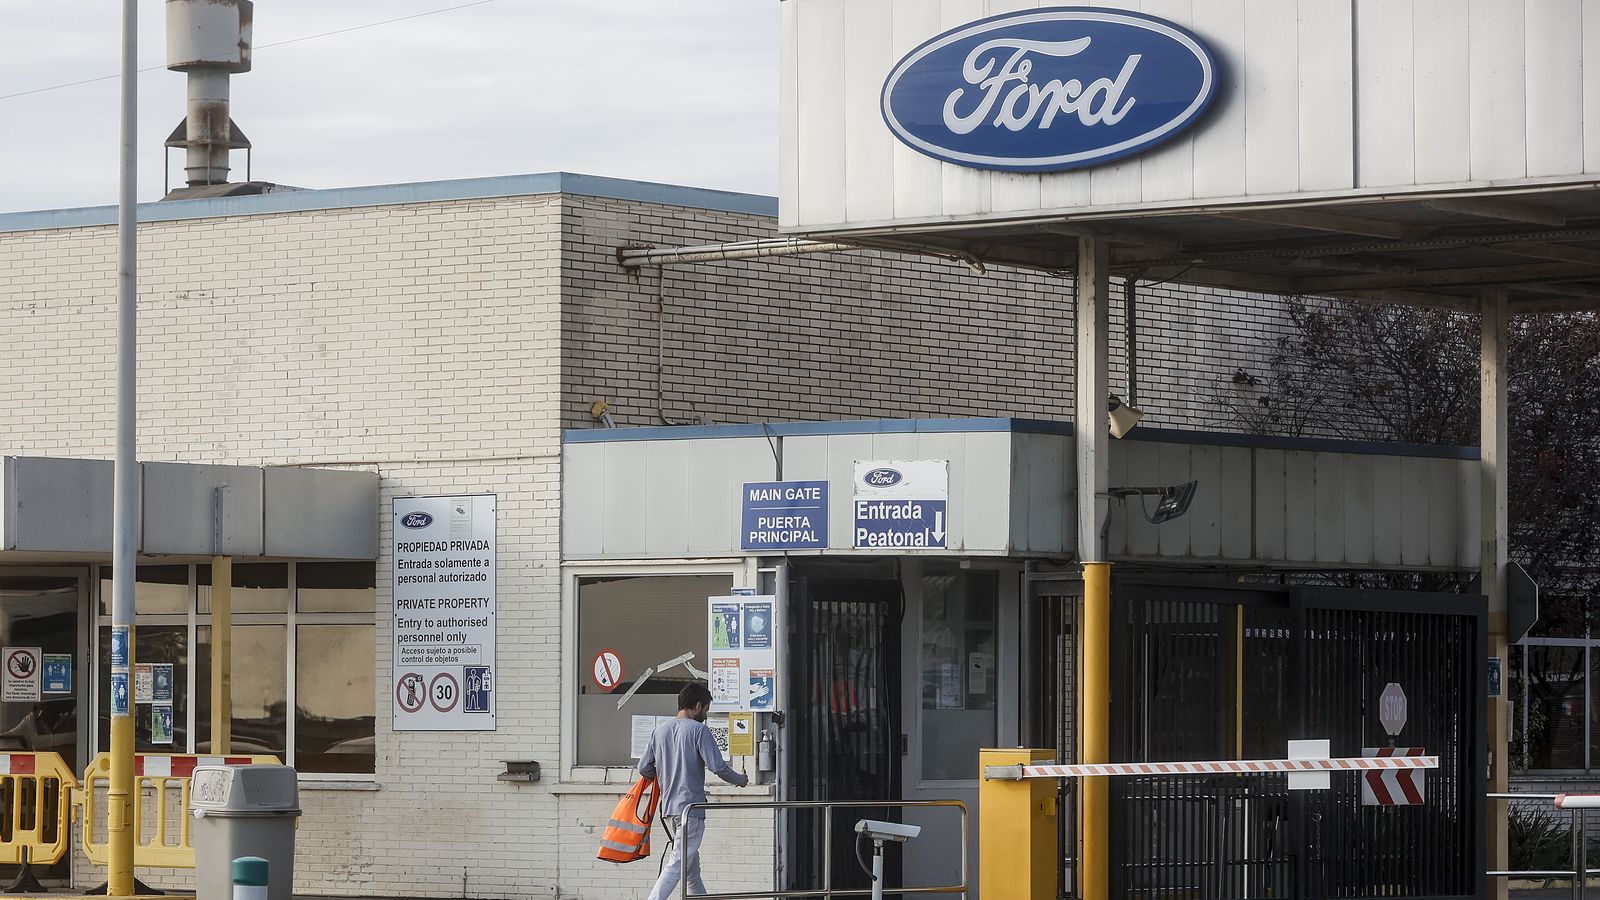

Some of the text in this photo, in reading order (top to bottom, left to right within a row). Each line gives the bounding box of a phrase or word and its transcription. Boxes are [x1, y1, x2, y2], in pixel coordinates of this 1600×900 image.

[942, 36, 1142, 135] Ford
[870, 471, 894, 484] Ford
[750, 488, 821, 501] MAIN GATE
[858, 501, 922, 520] Entrada
[407, 514, 427, 527] Ford
[758, 517, 810, 529] PUERTA
[750, 531, 819, 543] PRINCIPAL
[857, 528, 929, 547] Peatonal
[397, 540, 490, 553] PROPIEDAD PRIVADA
[398, 558, 490, 569] Entrada solamente a
[397, 571, 487, 586] personal autorizado
[397, 598, 490, 610] PRIVATE PROPERTY
[398, 617, 488, 630] Entry to authorised
[397, 632, 467, 644] personnel only
[426, 647, 446, 656] sujeto
[453, 646, 477, 655] posible
[425, 655, 433, 663] de
[435, 654, 459, 664] objetos
[436, 684, 452, 700] 30
[1384, 696, 1403, 721] STOP
